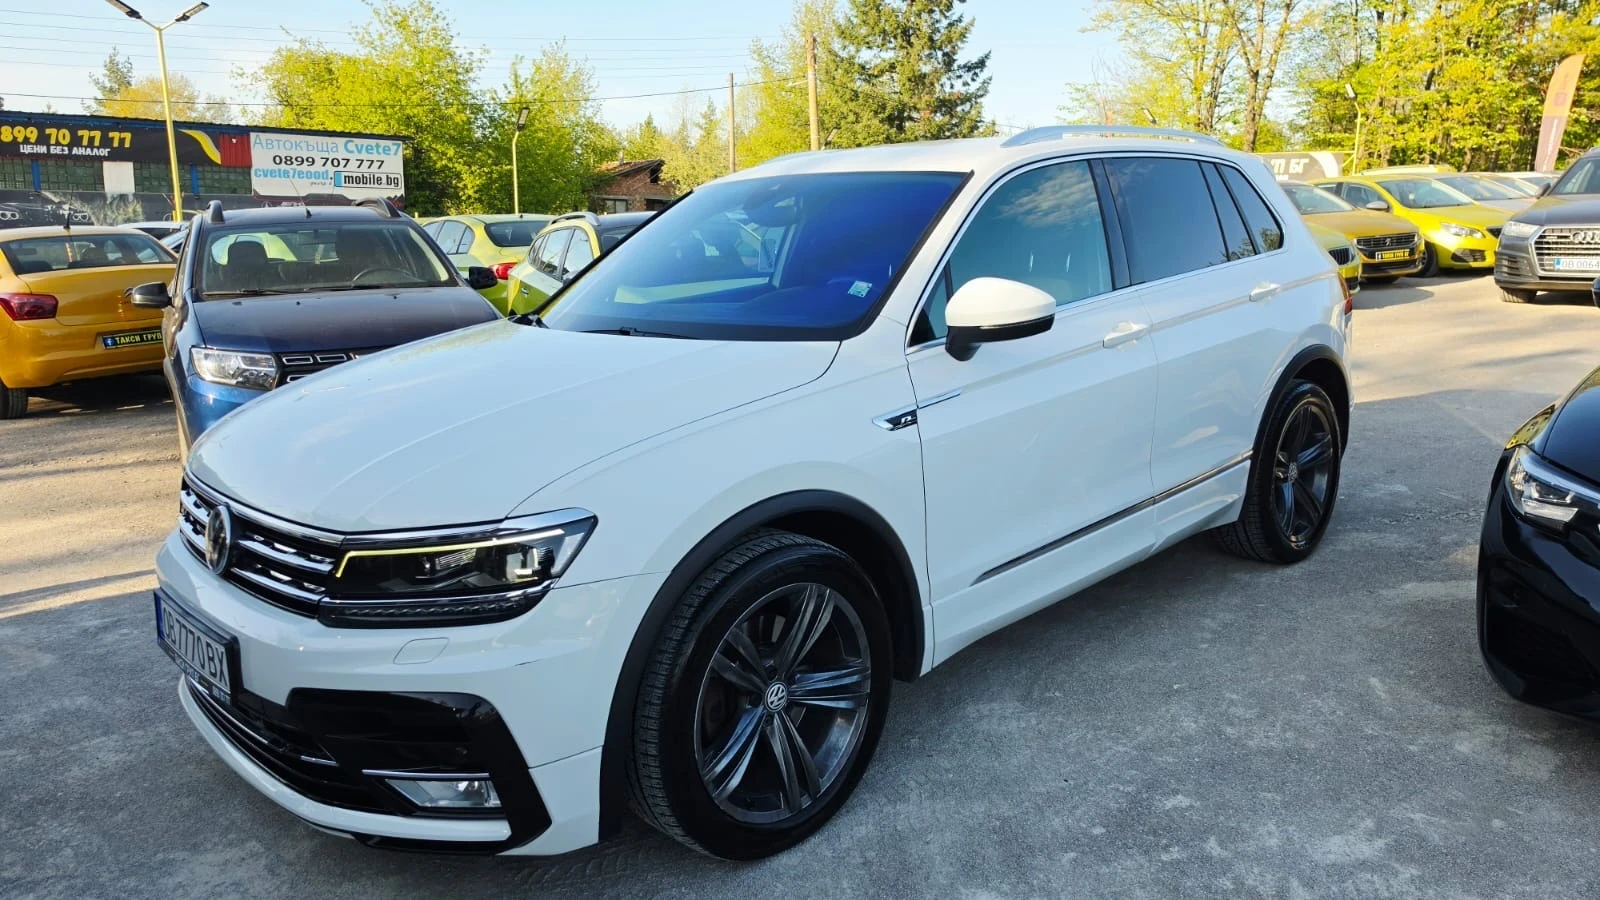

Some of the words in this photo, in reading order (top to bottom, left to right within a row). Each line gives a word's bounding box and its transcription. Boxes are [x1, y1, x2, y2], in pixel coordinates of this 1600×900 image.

[0, 126, 38, 143] 899
[45, 128, 71, 145] 70
[77, 130, 101, 146] 77
[108, 131, 132, 148] 77
[253, 134, 339, 154] Автокъща
[343, 139, 402, 156] Cvete7
[20, 144, 48, 155] ЦЕНИ
[50, 145, 69, 155] БЕЗ
[71, 147, 111, 157] АНАЛОГ
[272, 154, 316, 167] 0899
[320, 157, 351, 168] 707
[355, 158, 385, 170] 777
[343, 173, 399, 187] mobile.bg
